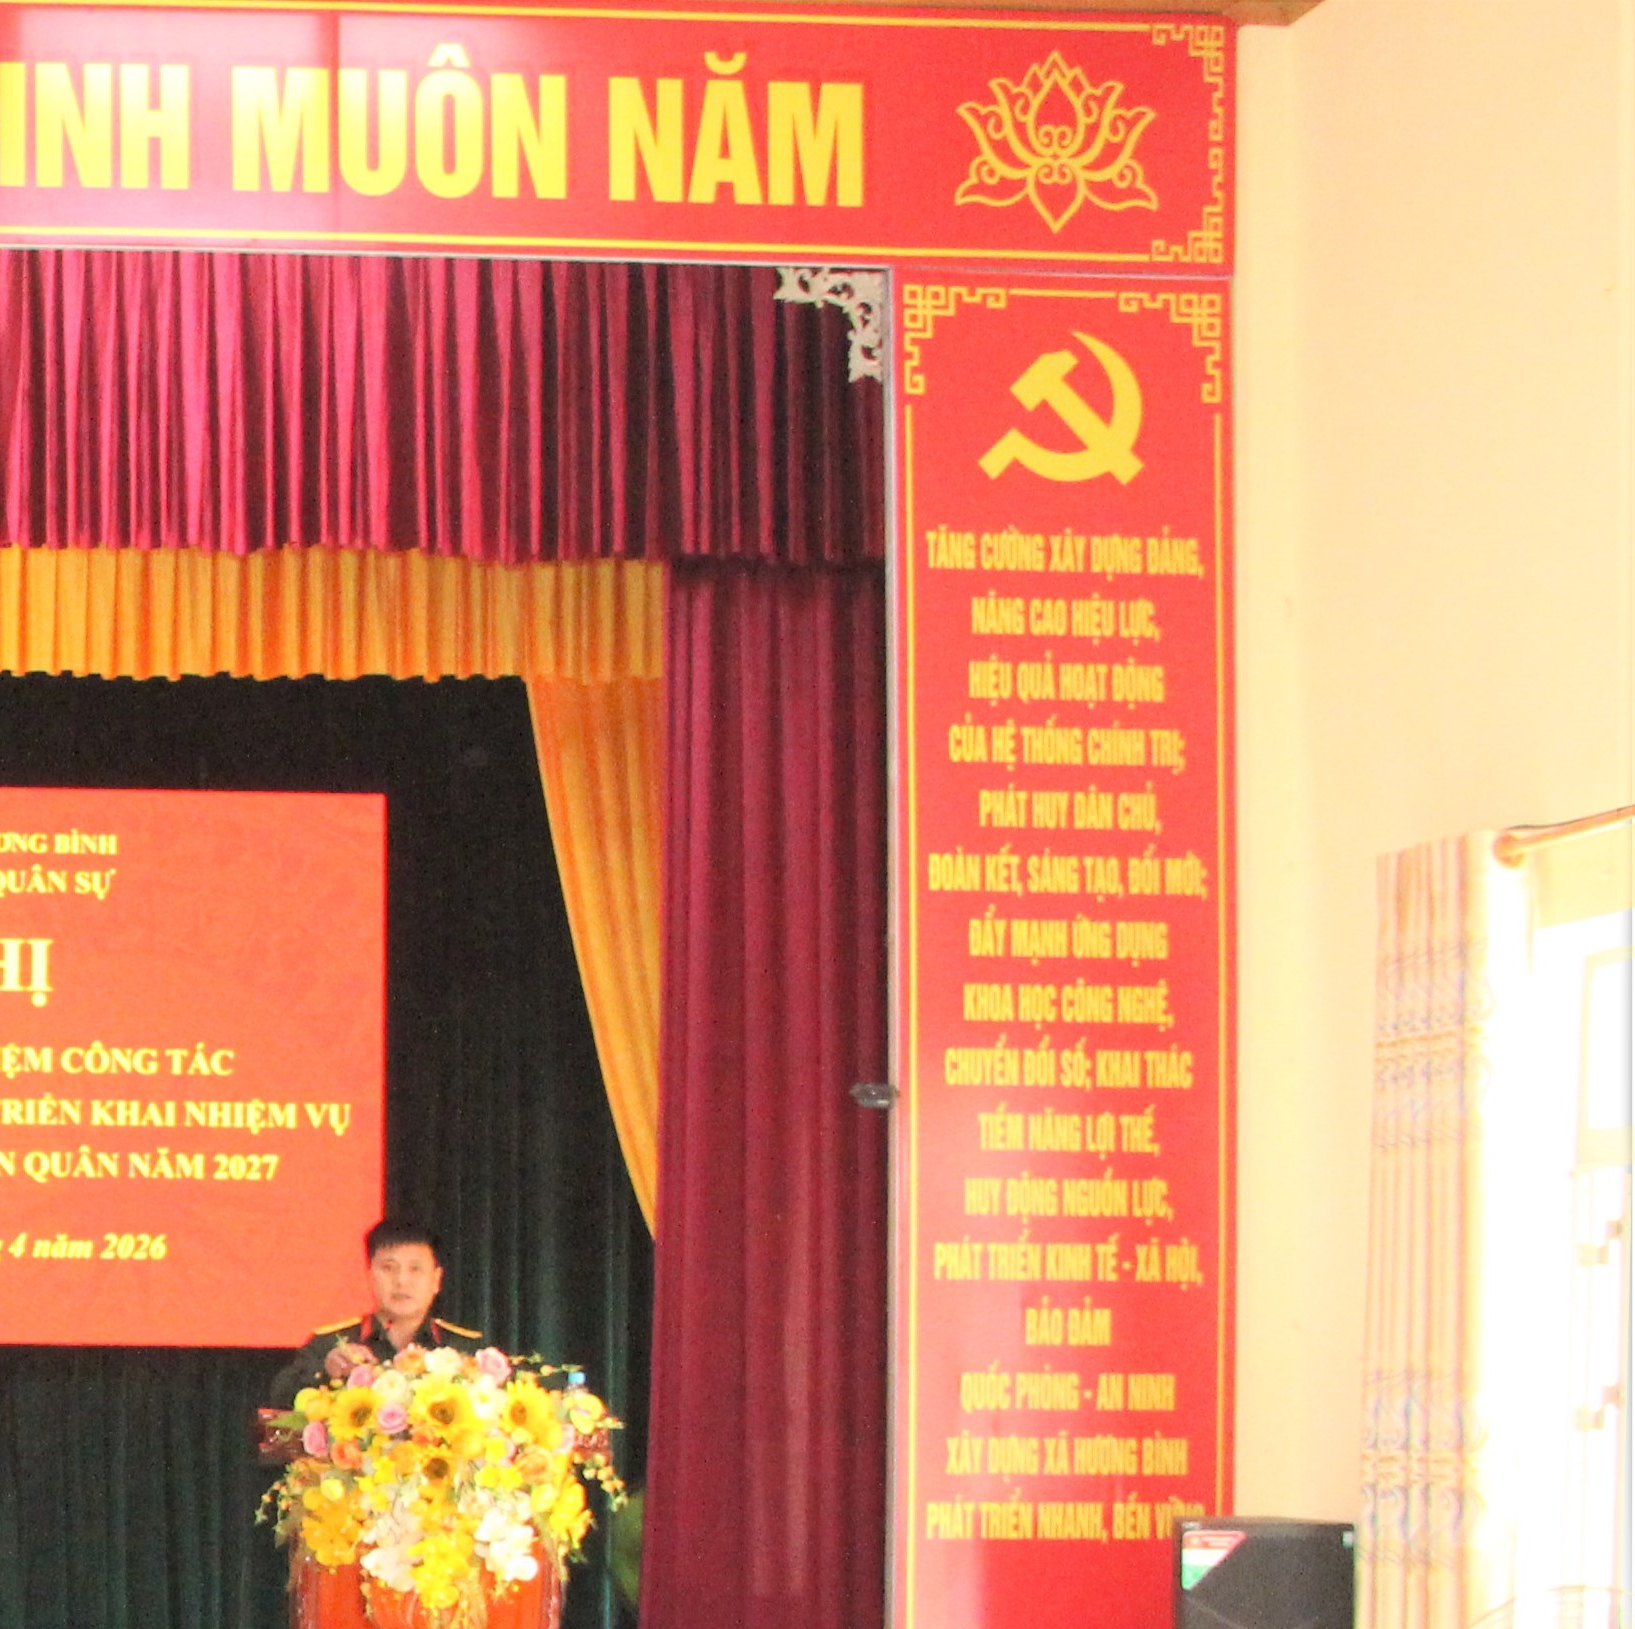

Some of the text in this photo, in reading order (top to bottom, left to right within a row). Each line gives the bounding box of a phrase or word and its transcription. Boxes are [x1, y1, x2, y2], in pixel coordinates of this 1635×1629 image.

[231, 43, 568, 200] MUÔN
[607, 51, 865, 208] NĂM
[54, 829, 117, 854] BÌNH
[75, 867, 116, 899] SỰ
[60, 1041, 159, 1075] CÔNG
[165, 1042, 235, 1076] TÁC
[90, 1100, 177, 1127] KHAI
[184, 1098, 298, 1135] NHIỆM
[304, 1103, 351, 1136] VỤ
[23, 1145, 119, 1183] QUÂN
[128, 1147, 205, 1179] NĂM
[213, 1153, 279, 1181] 2027
[8, 1232, 28, 1258] 4
[32, 1234, 94, 1259] năm
[100, 1233, 167, 1260] 2026
